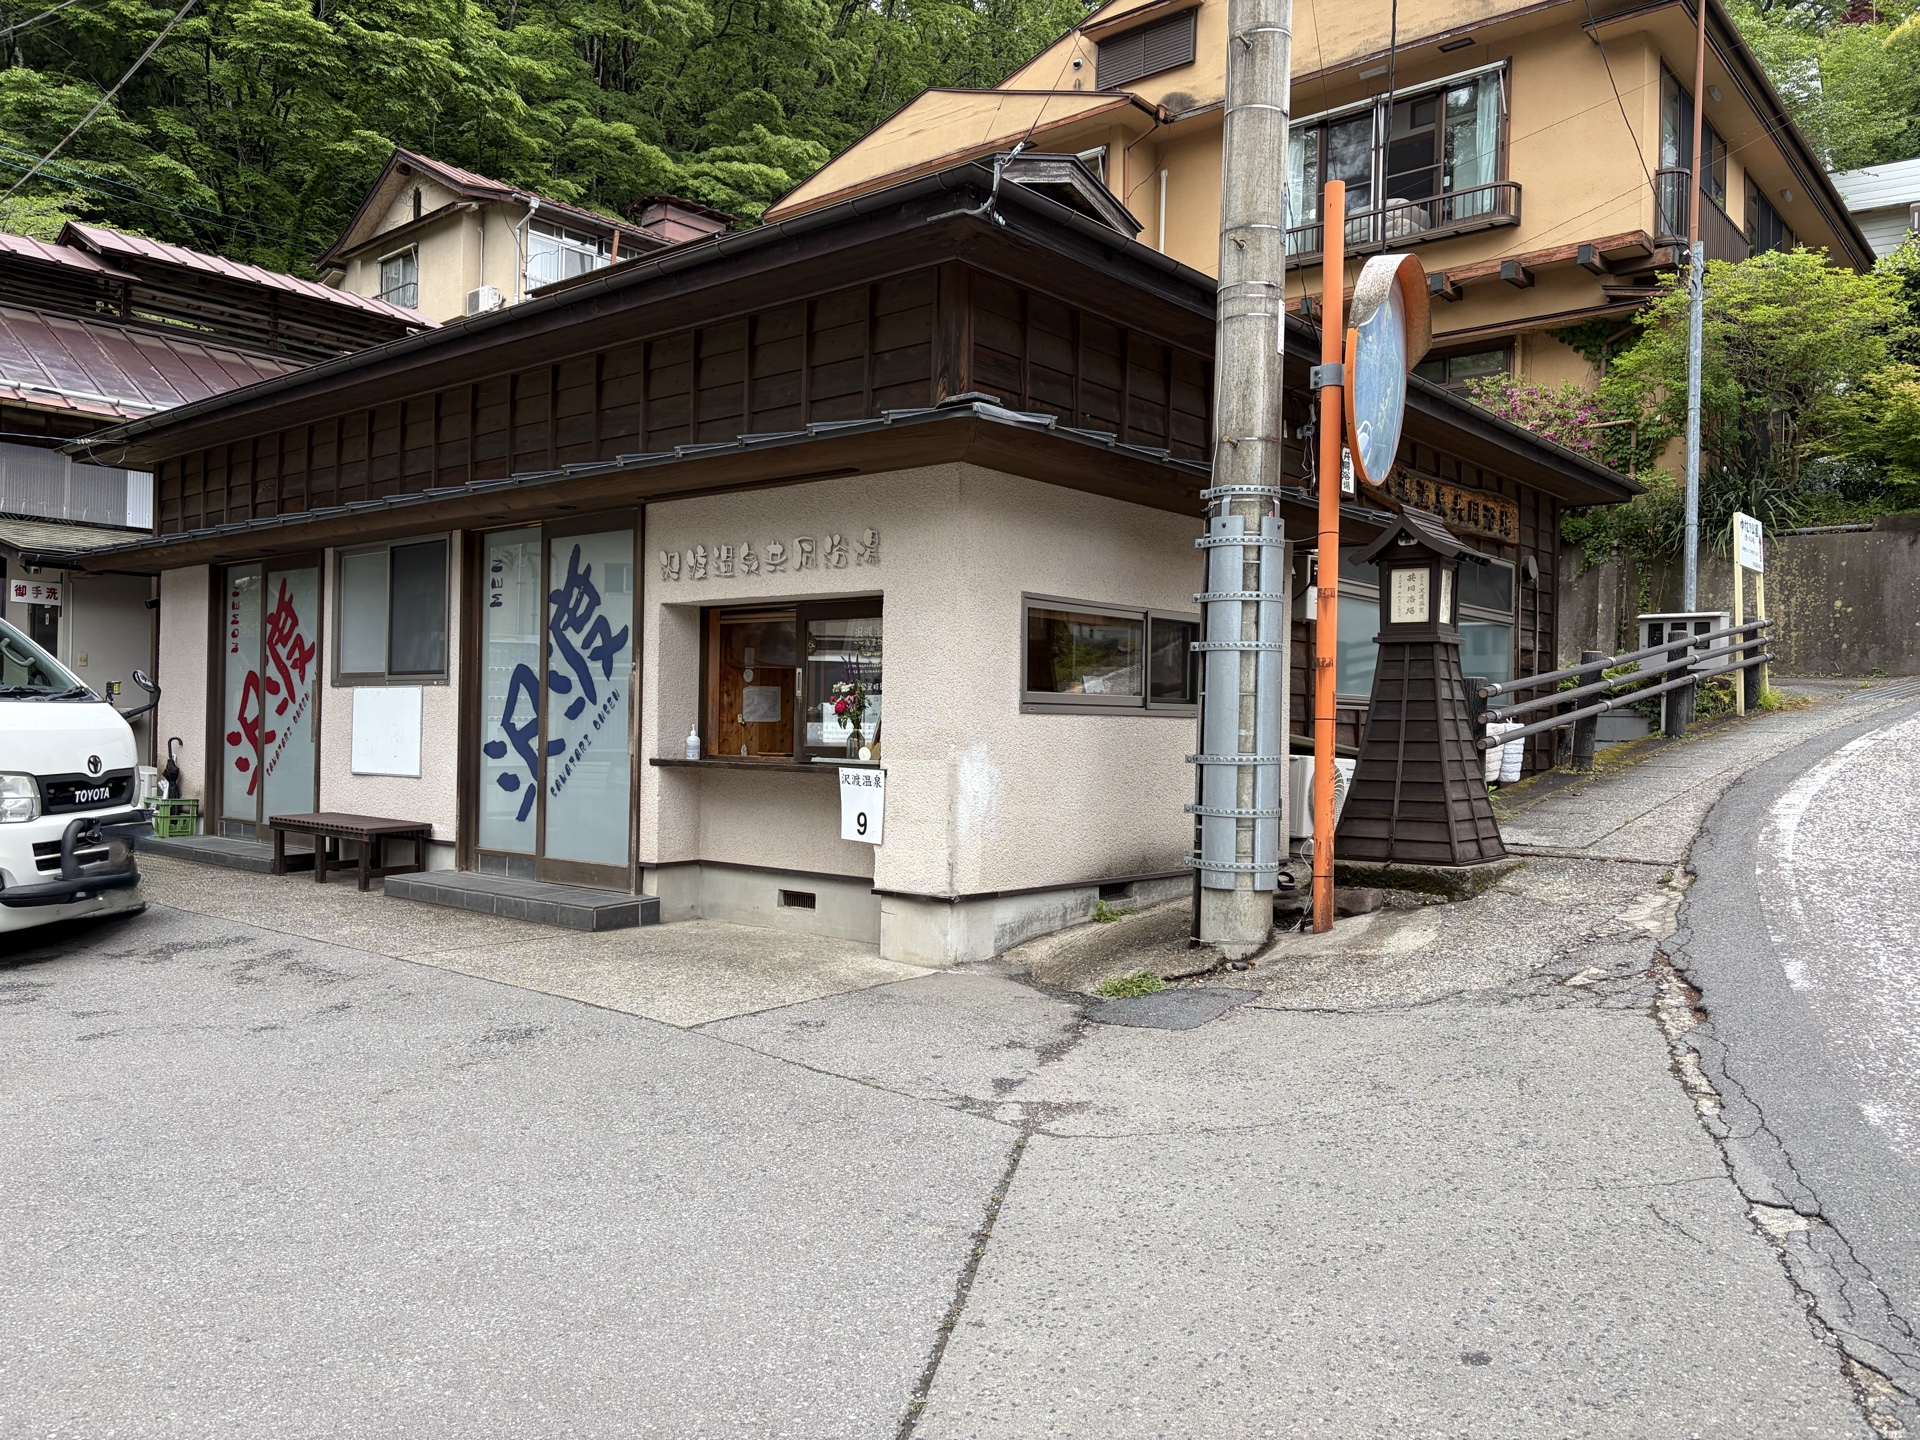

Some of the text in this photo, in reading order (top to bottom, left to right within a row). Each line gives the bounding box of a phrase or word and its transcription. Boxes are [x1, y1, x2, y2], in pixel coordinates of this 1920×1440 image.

[14, 584, 59, 600] 御手洗
[489, 559, 503, 608] MEN
[230, 586, 240, 654] WOMEN
[841, 773, 882, 788] 沢渡温泉
[75, 786, 110, 804] TOYOTA
[856, 811, 868, 836] 9
